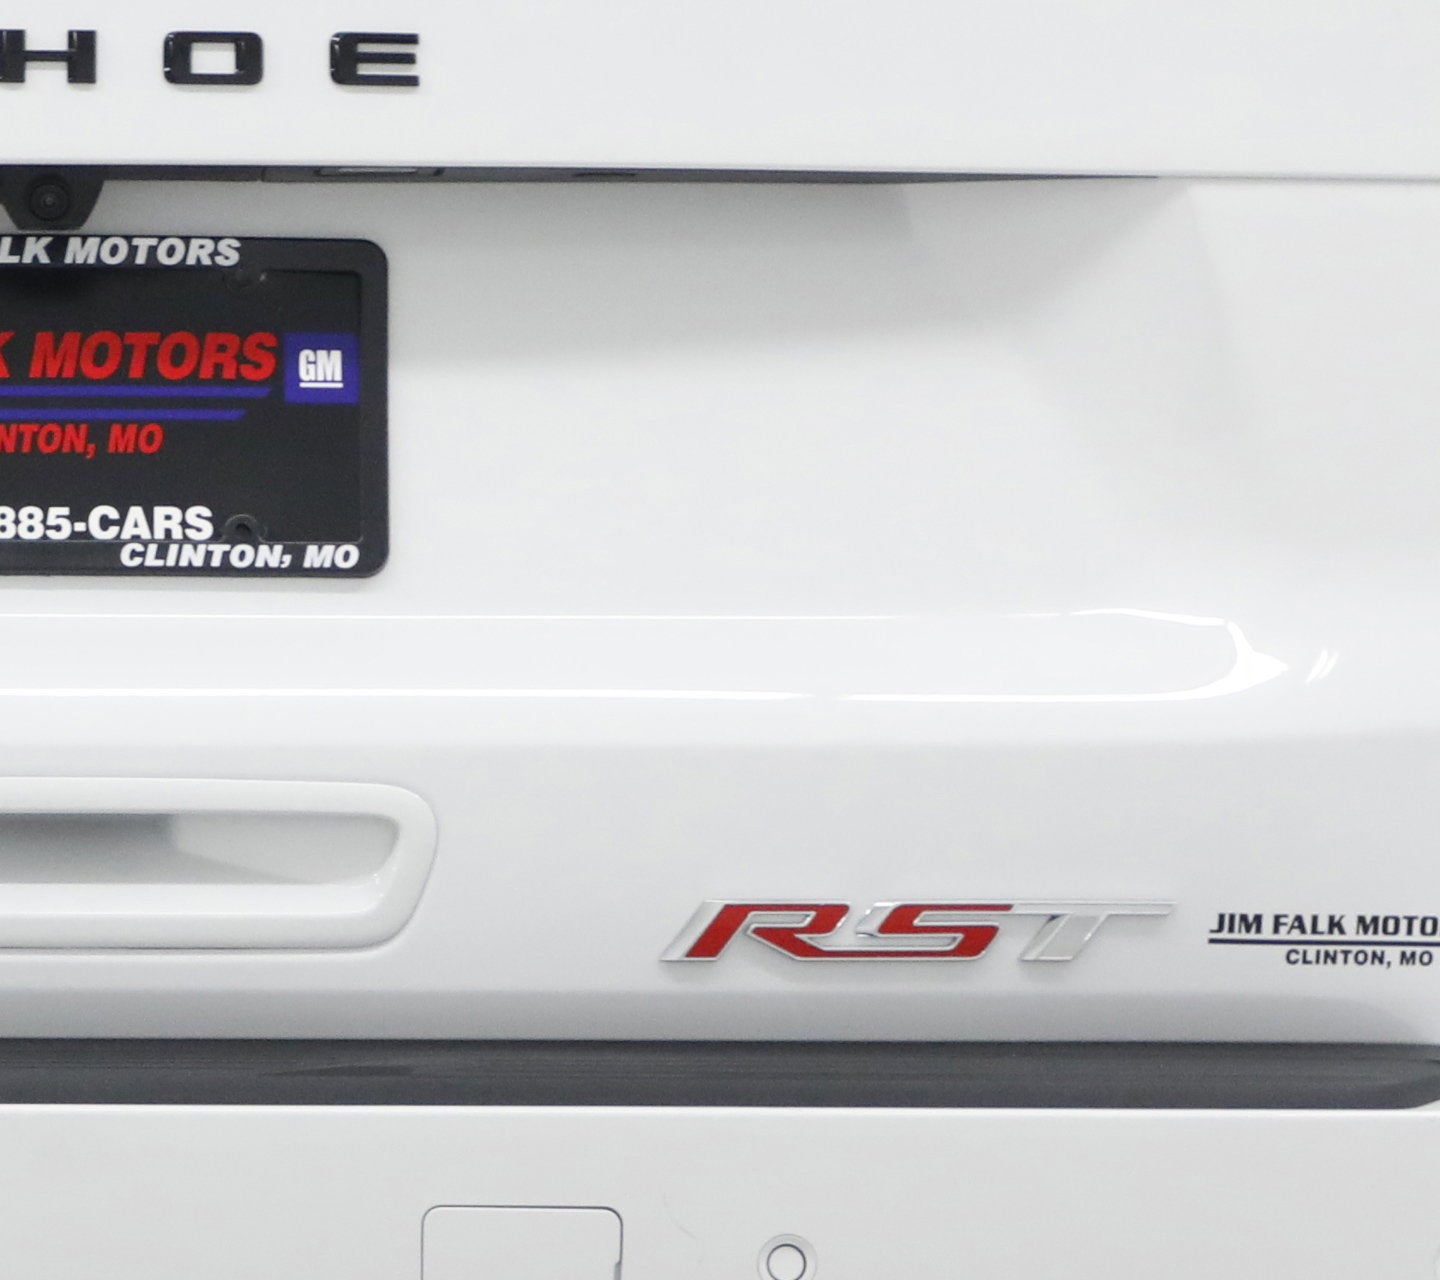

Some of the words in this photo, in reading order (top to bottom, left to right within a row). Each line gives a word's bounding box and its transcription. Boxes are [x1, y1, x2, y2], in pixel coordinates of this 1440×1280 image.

[64, 236, 242, 267] MOTORS
[28, 330, 278, 381] MOTORS
[298, 348, 343, 383] GM
[107, 423, 165, 454] MO
[119, 542, 293, 569] CLINTON,
[302, 543, 360, 569] MO
[660, 900, 1178, 962] RST
[1209, 913, 1263, 935] JIM
[1272, 914, 1346, 936] FALK
[1285, 948, 1393, 969] CLINTON,
[1399, 950, 1434, 966] MO
